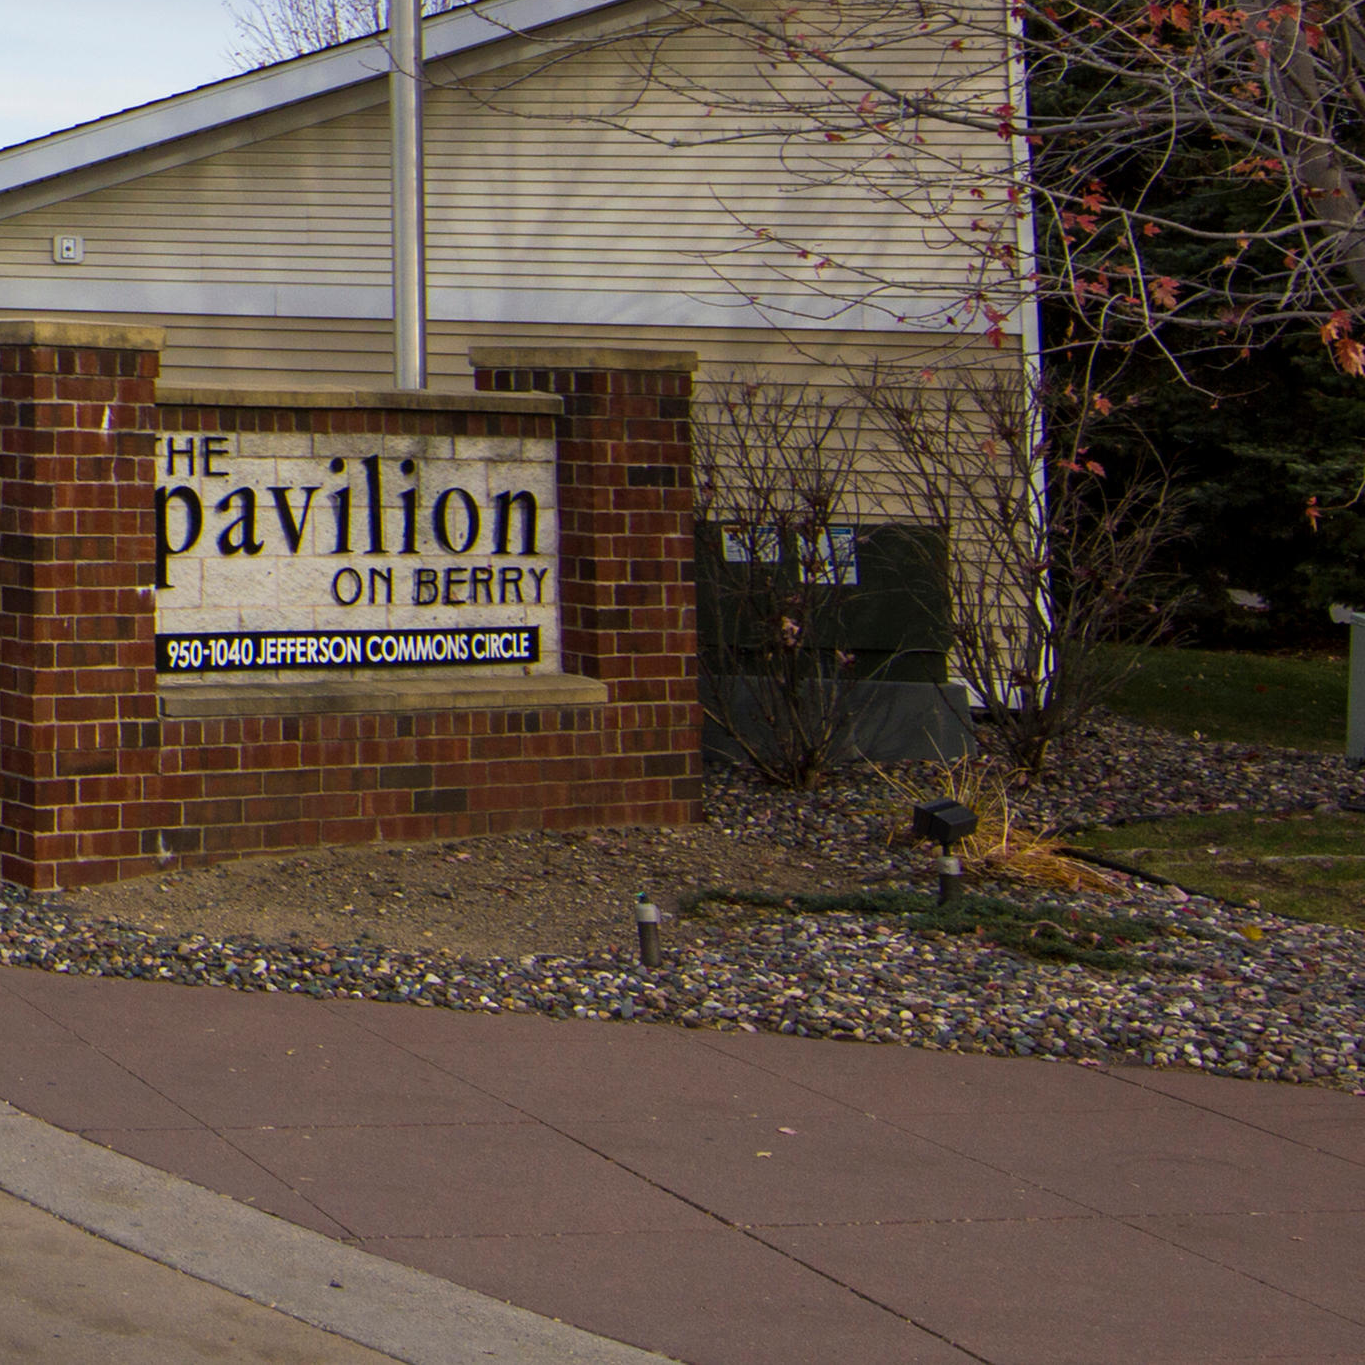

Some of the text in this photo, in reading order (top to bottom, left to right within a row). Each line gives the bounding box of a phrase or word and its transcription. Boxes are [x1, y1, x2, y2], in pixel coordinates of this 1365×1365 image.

[155, 436, 230, 477] HE
[155, 454, 541, 590] pavilion
[331, 566, 549, 606] ON BERRY
[167, 632, 530, 669] 950-1040 JEFFERSON COMMONS CIRCLE
